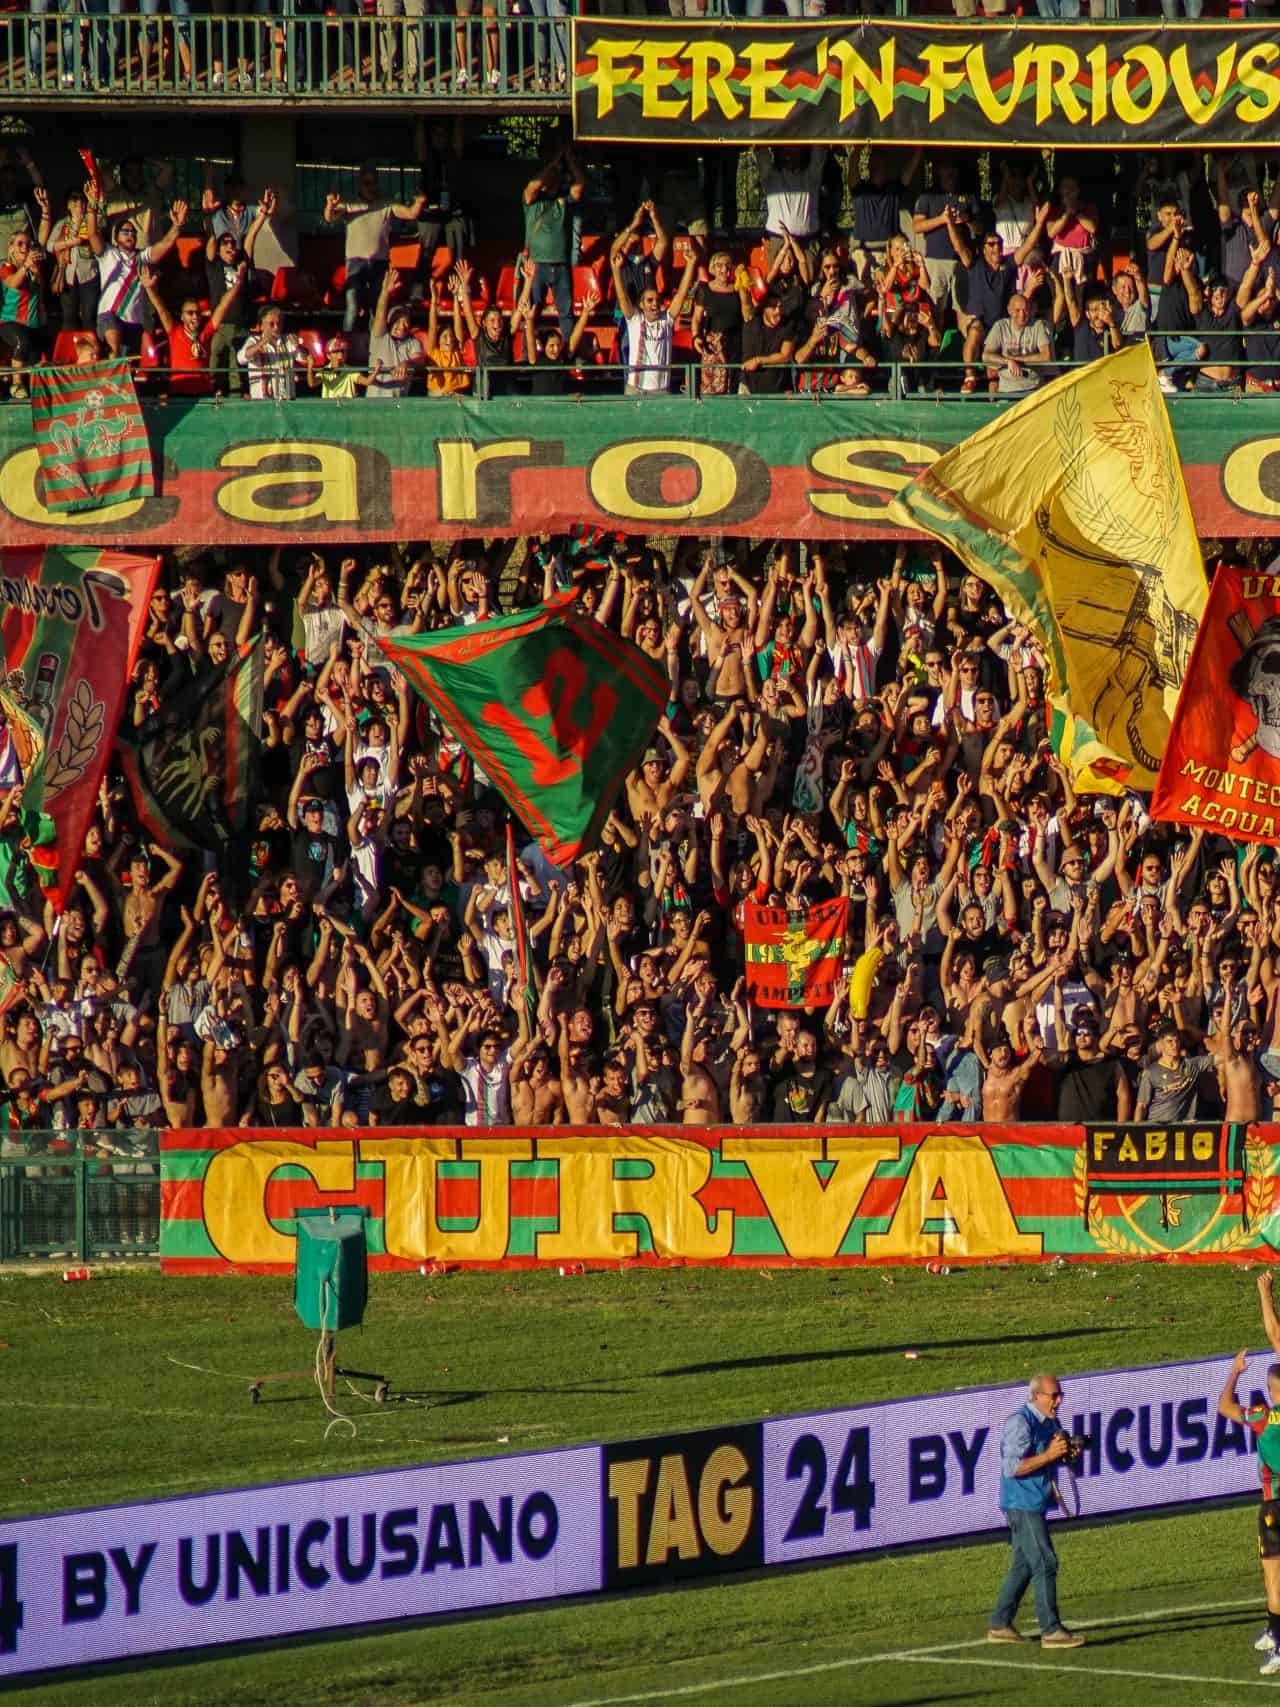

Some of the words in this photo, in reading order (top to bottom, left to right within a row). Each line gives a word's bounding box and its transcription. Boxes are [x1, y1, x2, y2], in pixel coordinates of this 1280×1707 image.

[587, 38, 796, 121] FERE
[817, 37, 896, 124] 'N
[202, 1136, 1043, 1264] CURVA
[1093, 1131, 1214, 1162] FABIO
[608, 1443, 755, 1569] TAG
[783, 1426, 876, 1543] 24
[909, 1426, 990, 1503] BY
[62, 1544, 157, 1625] BY
[177, 1490, 559, 1607] UNICUSANO
